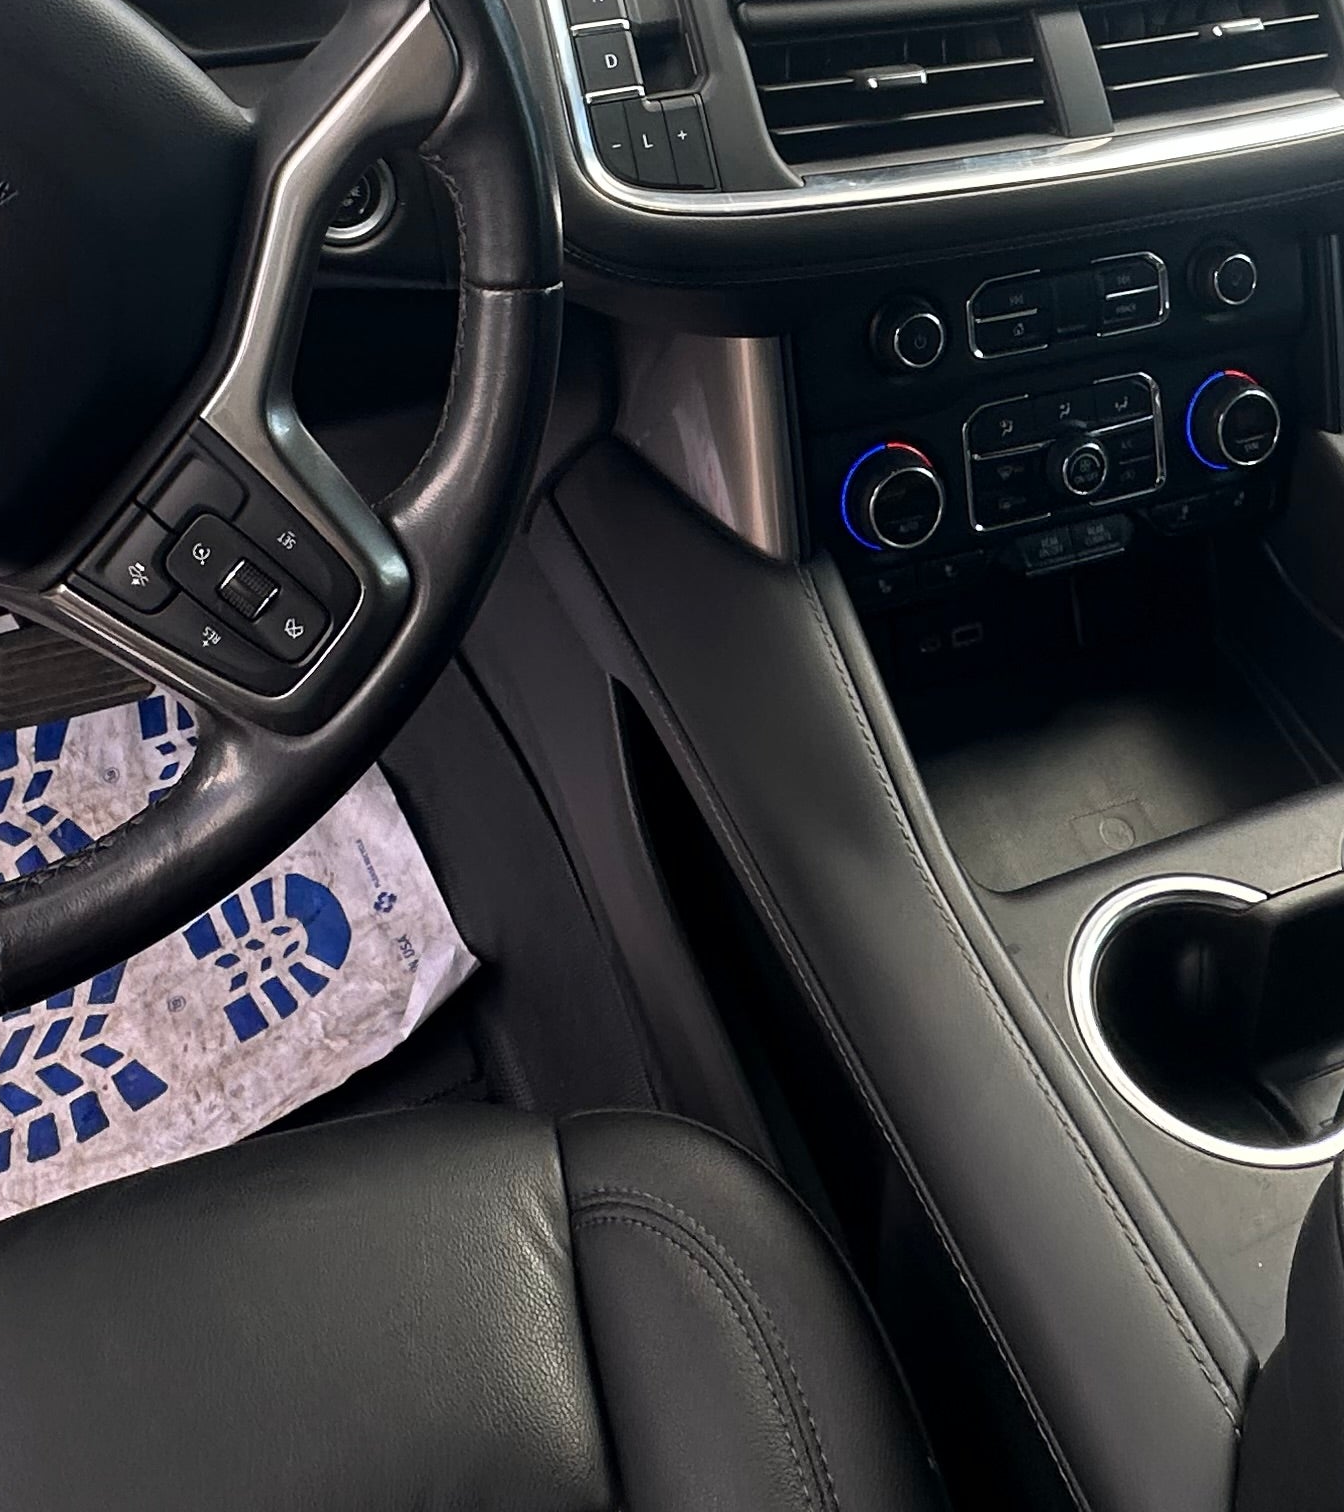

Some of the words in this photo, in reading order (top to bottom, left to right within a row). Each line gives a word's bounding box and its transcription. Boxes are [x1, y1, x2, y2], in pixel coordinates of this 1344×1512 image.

[604, 53, 619, 69] D
[641, 133, 654, 149] L
[276, 532, 297, 550] SET
[202, 626, 222, 645] RES
[397, 934, 416, 959] USA
